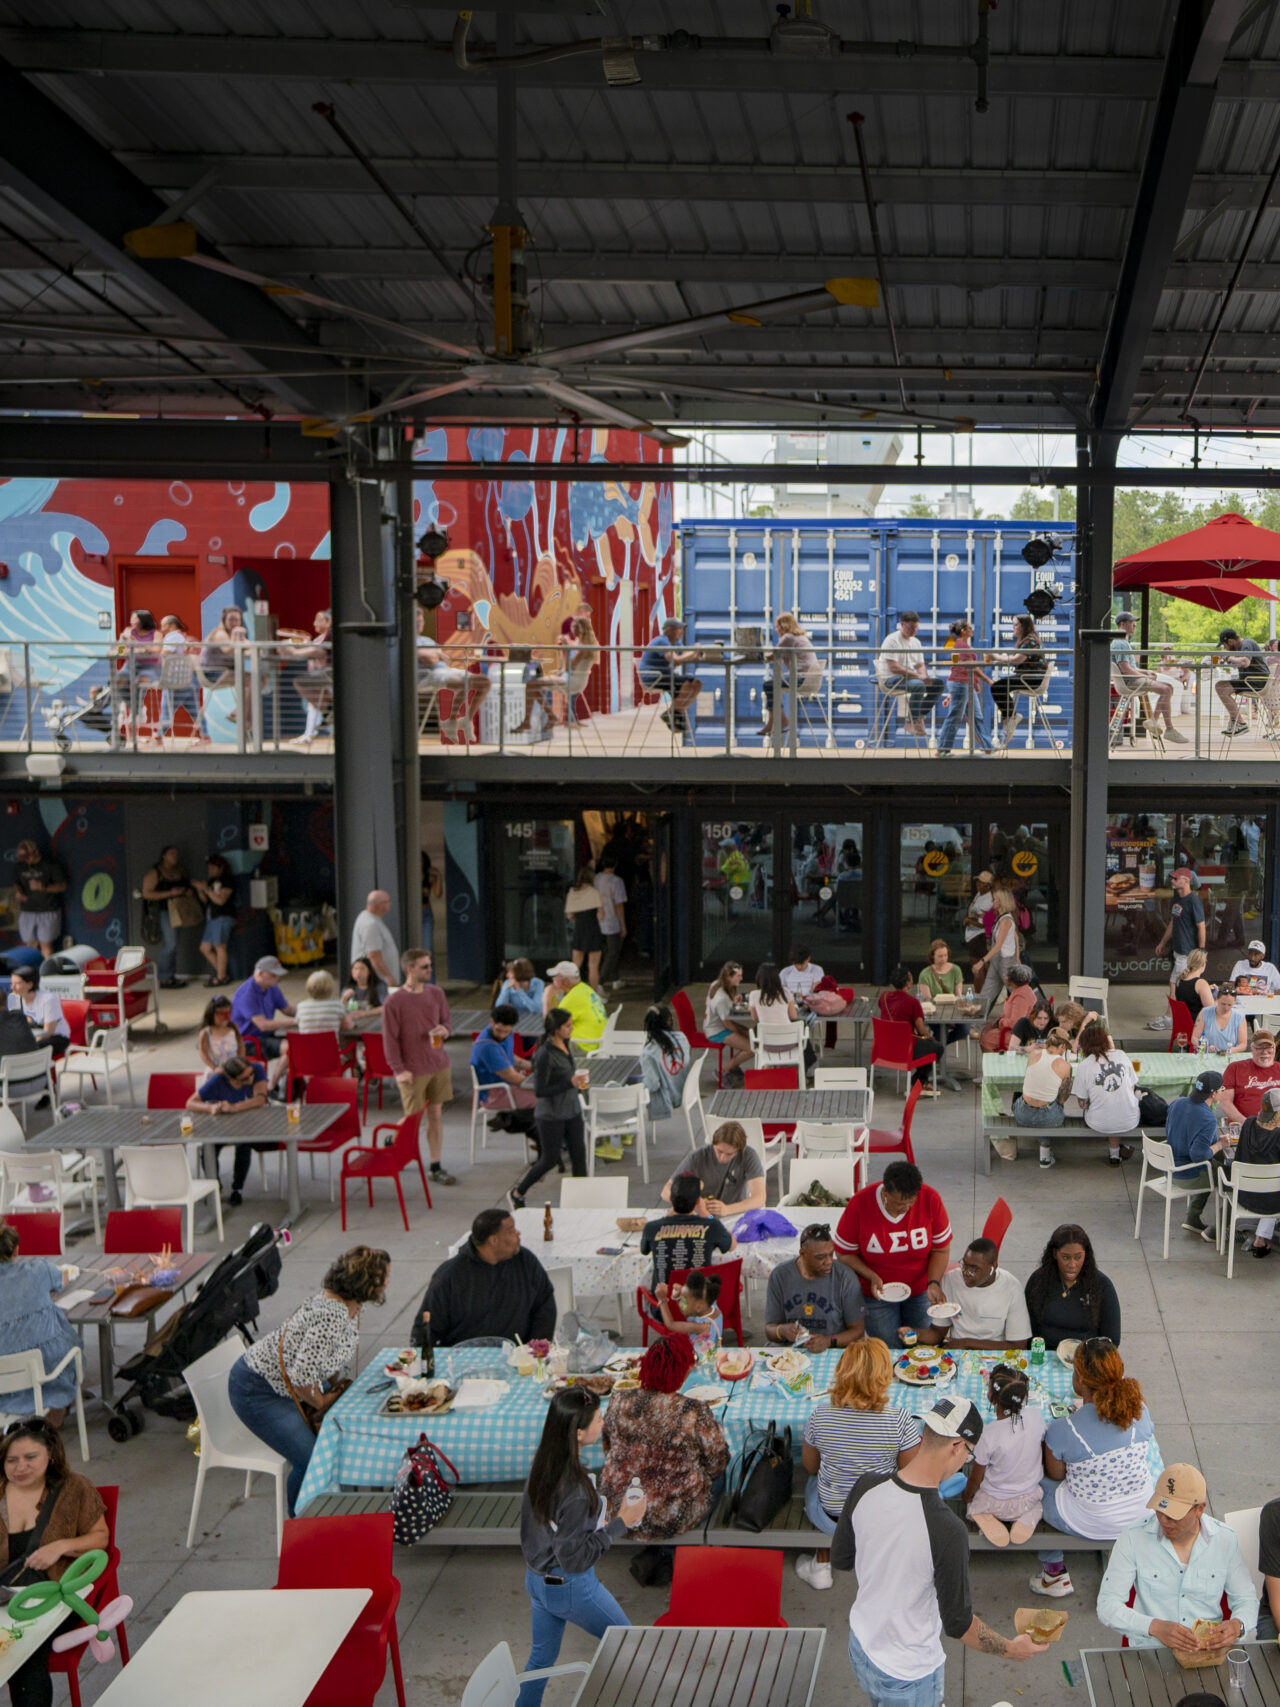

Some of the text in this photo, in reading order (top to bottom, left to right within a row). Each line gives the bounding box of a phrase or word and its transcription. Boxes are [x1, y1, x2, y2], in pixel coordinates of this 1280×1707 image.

[504, 823, 533, 838] 145
[705, 824, 732, 839] 150
[654, 1225, 710, 1241] JOURNEY
